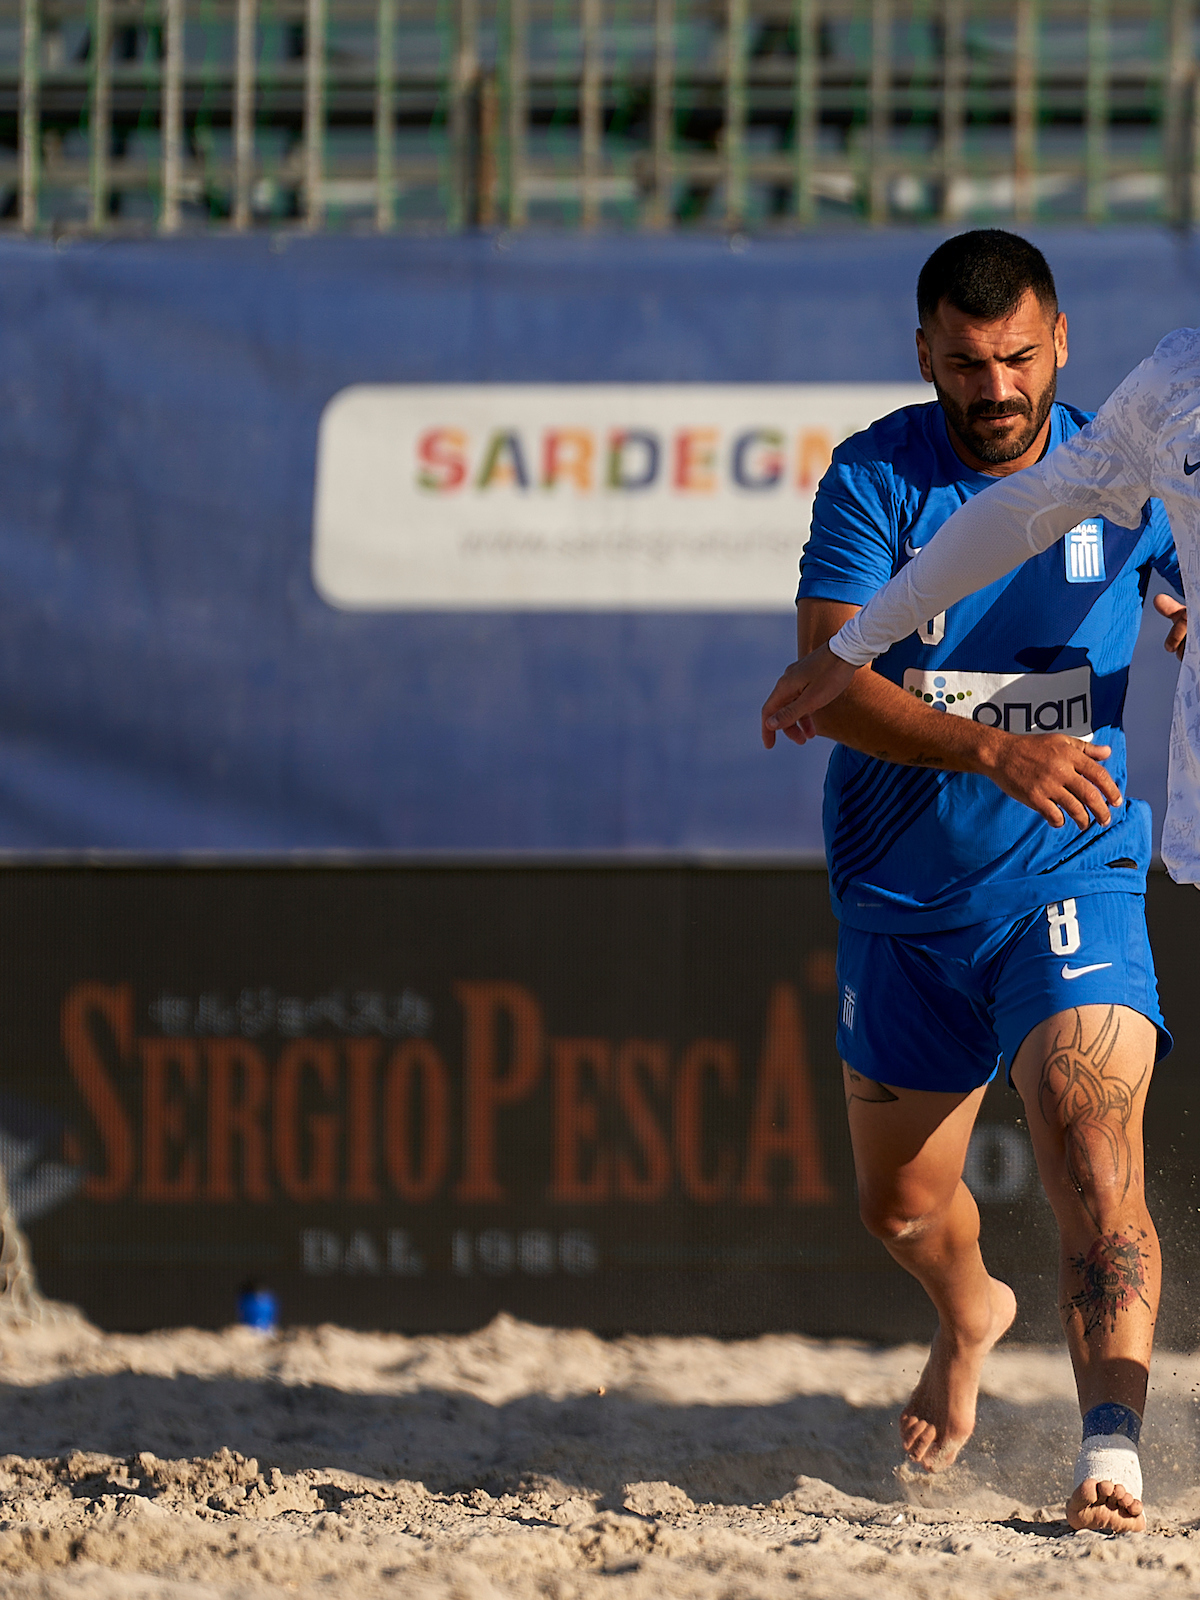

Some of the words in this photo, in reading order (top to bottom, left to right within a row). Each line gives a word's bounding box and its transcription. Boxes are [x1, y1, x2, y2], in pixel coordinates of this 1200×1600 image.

[416, 427, 834, 494] SARDEGN
[1046, 898, 1081, 956] 8
[301, 1228, 427, 1276] DAL
